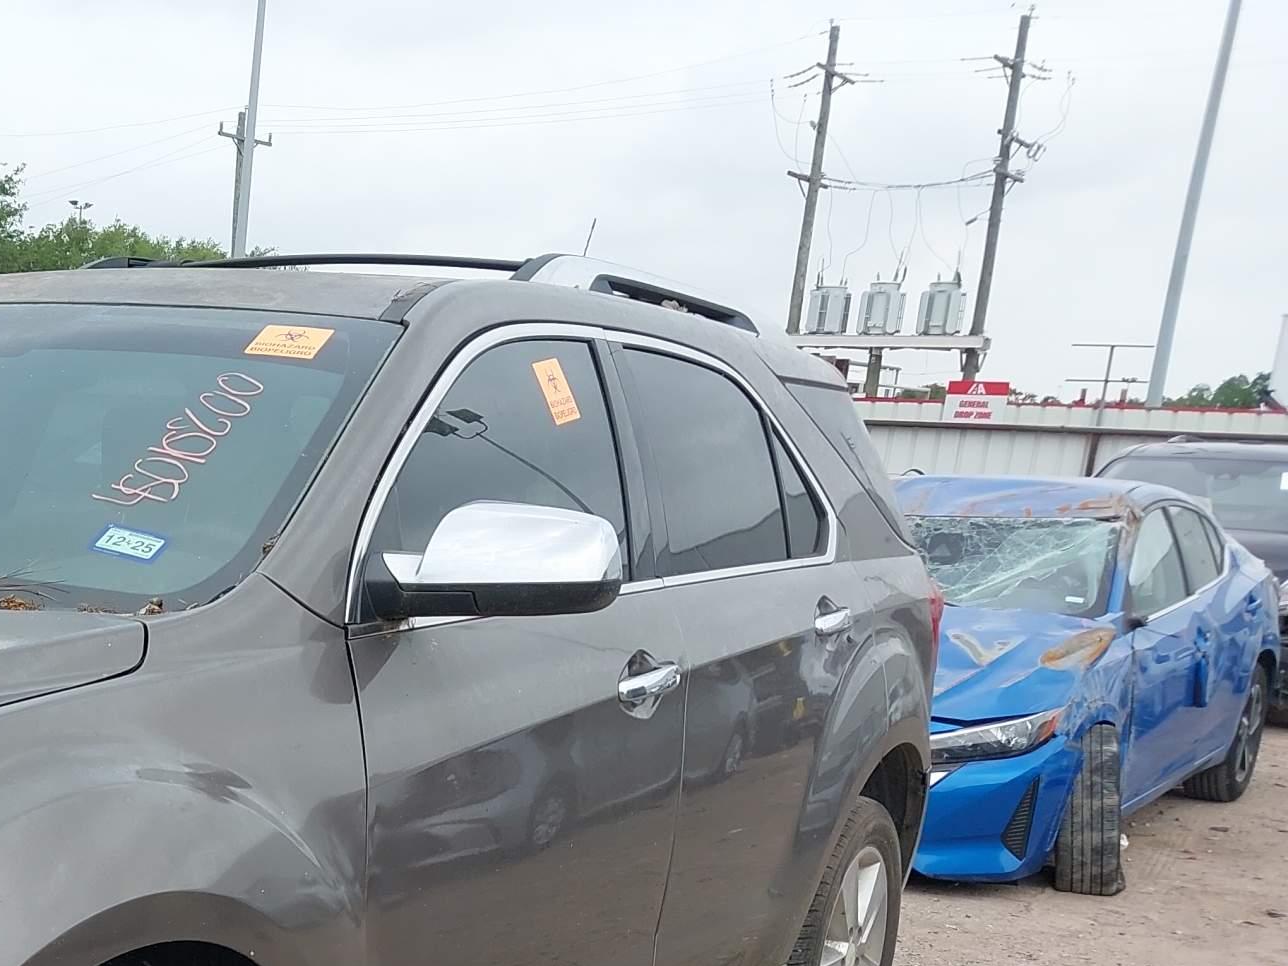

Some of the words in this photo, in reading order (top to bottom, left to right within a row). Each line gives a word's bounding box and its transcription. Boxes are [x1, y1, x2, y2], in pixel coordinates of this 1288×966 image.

[958, 400, 989, 409] GENERAL
[953, 411, 974, 419] DROP
[974, 411, 993, 419] ZONE
